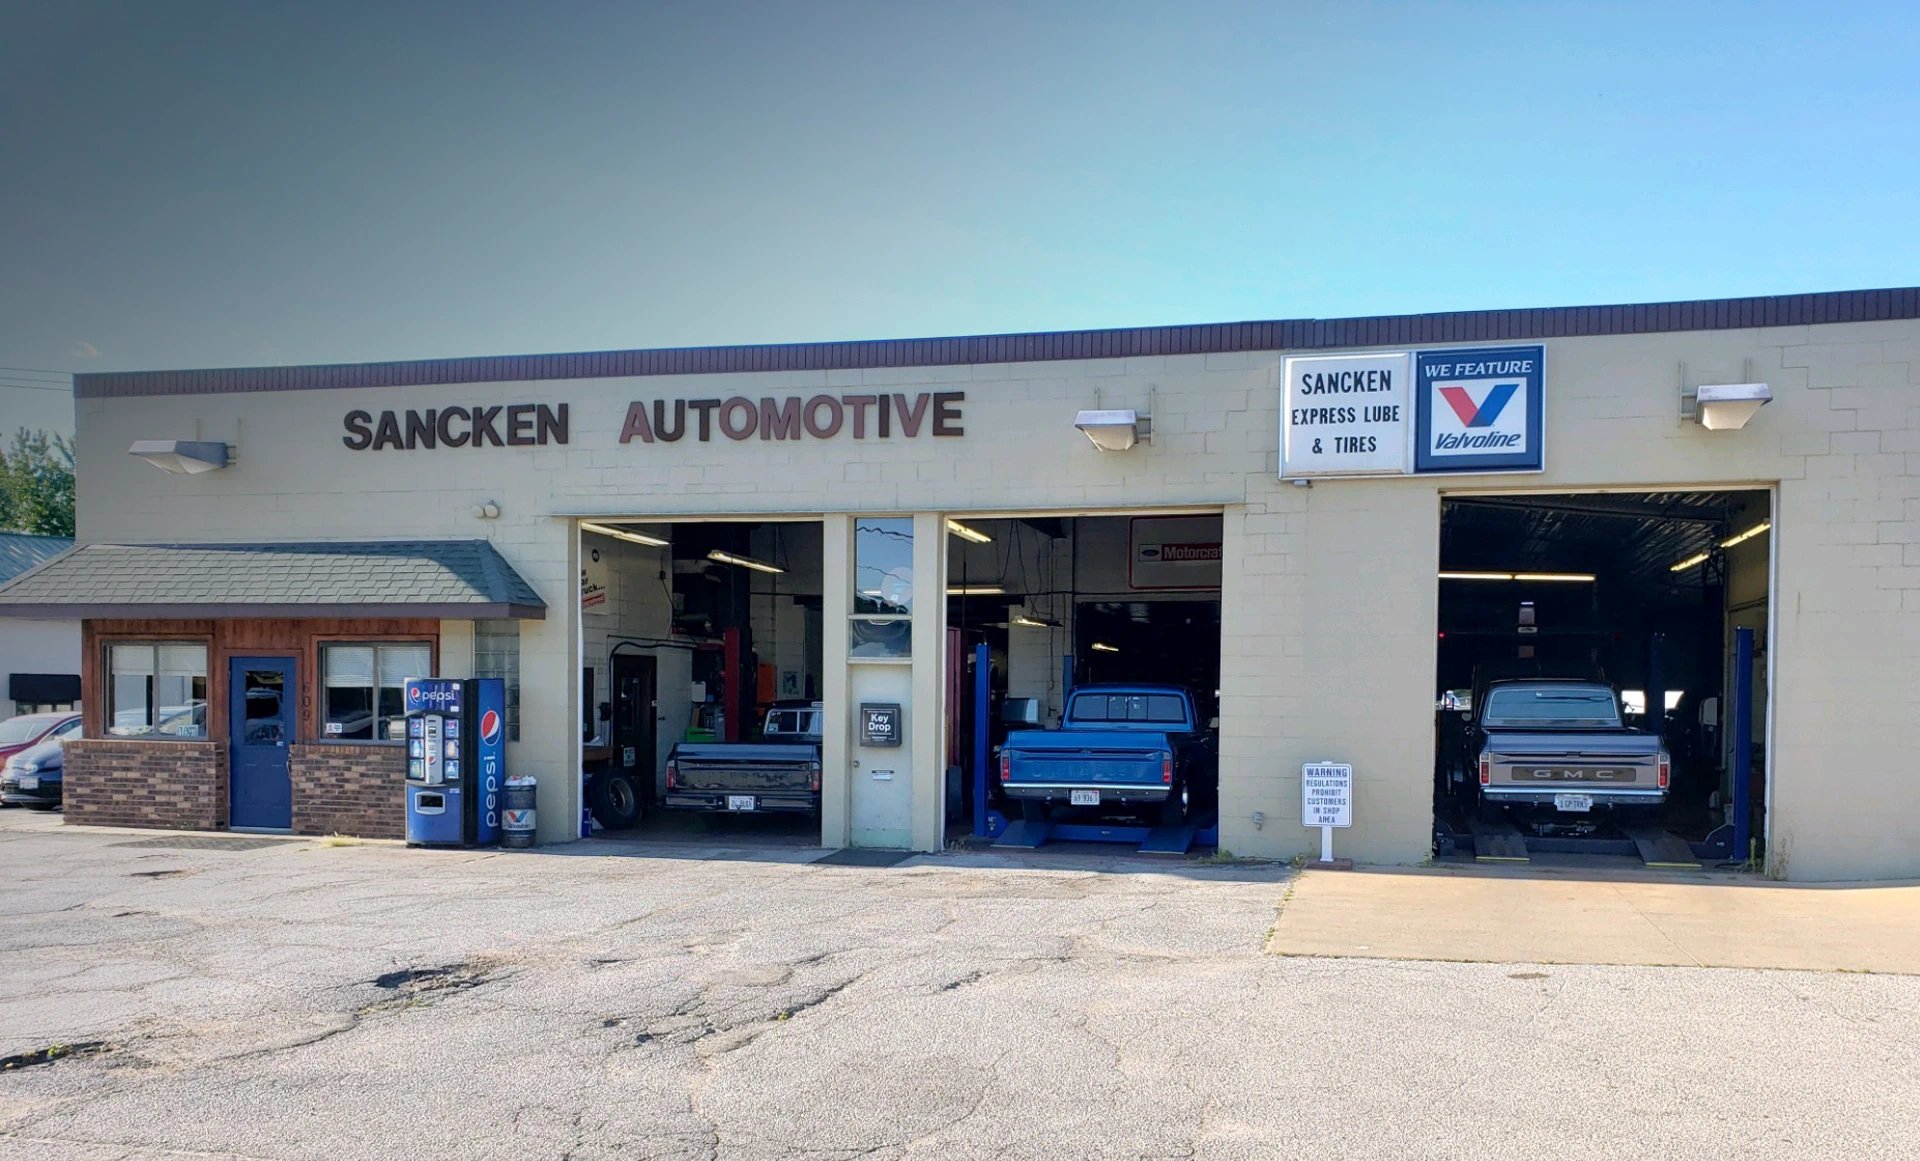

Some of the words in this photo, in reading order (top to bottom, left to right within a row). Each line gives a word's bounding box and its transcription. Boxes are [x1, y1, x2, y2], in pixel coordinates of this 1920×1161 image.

[1424, 363, 1451, 377] WE
[1454, 360, 1533, 376] FEATURE
[1301, 370, 1392, 395] SANCKEN
[342, 402, 569, 450] SANCKEN
[618, 390, 966, 444] AUTOMOTIVE
[1291, 406, 1356, 426] EXPRESS
[1364, 404, 1400, 423] LUBE
[1312, 438, 1323, 454] &
[1334, 436, 1377, 454] TIRES
[1434, 431, 1521, 450] Valvoline
[1164, 546, 1223, 560] Motorcraf
[422, 690, 455, 702] pepsi
[870, 713, 889, 724] Key
[868, 722, 891, 732] Drop
[1306, 767, 1348, 777] WARNING
[1533, 769, 1614, 779] GMC
[1306, 779, 1348, 788] REGULATIONS
[484, 755, 499, 828] pepsi
[1311, 788, 1342, 796] PROHIBIT
[1307, 798, 1347, 806] CUSTOMERS
[1313, 806, 1320, 814] IN
[1323, 806, 1341, 815] SHOP
[1318, 816, 1336, 824] AREA
